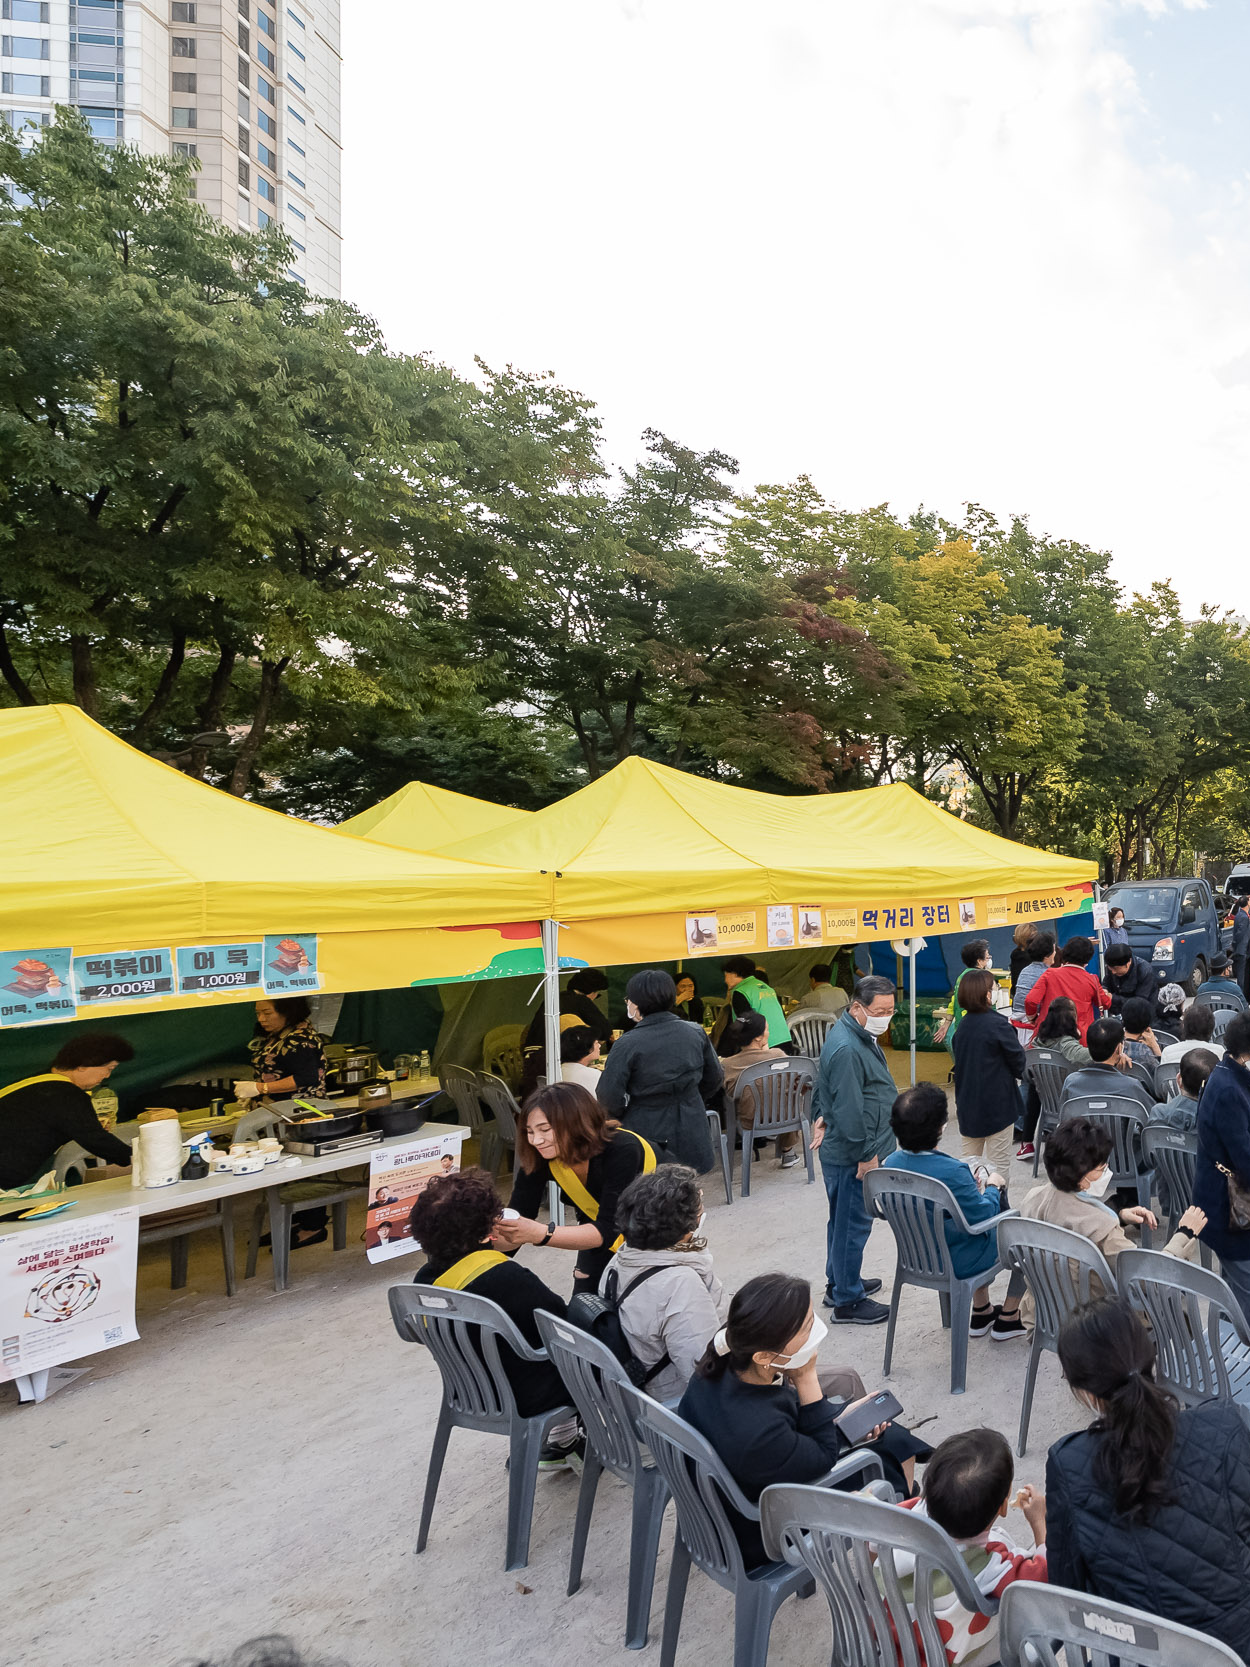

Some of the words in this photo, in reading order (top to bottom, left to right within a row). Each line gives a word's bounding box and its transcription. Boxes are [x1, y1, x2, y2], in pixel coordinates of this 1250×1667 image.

[1015, 896, 1065, 914] 새마을부녀회
[828, 918, 856, 928] 10,000원
[862, 909, 914, 931] 먹거리
[922, 904, 950, 926] 장터
[718, 922, 754, 934] 10,000원
[85, 954, 162, 978] 떡볶이
[97, 980, 156, 997] 2,000원
[197, 972, 247, 988] 1,000원
[26, 1258, 60, 1274] 서로에
[62, 1247, 106, 1264] 스며들다
